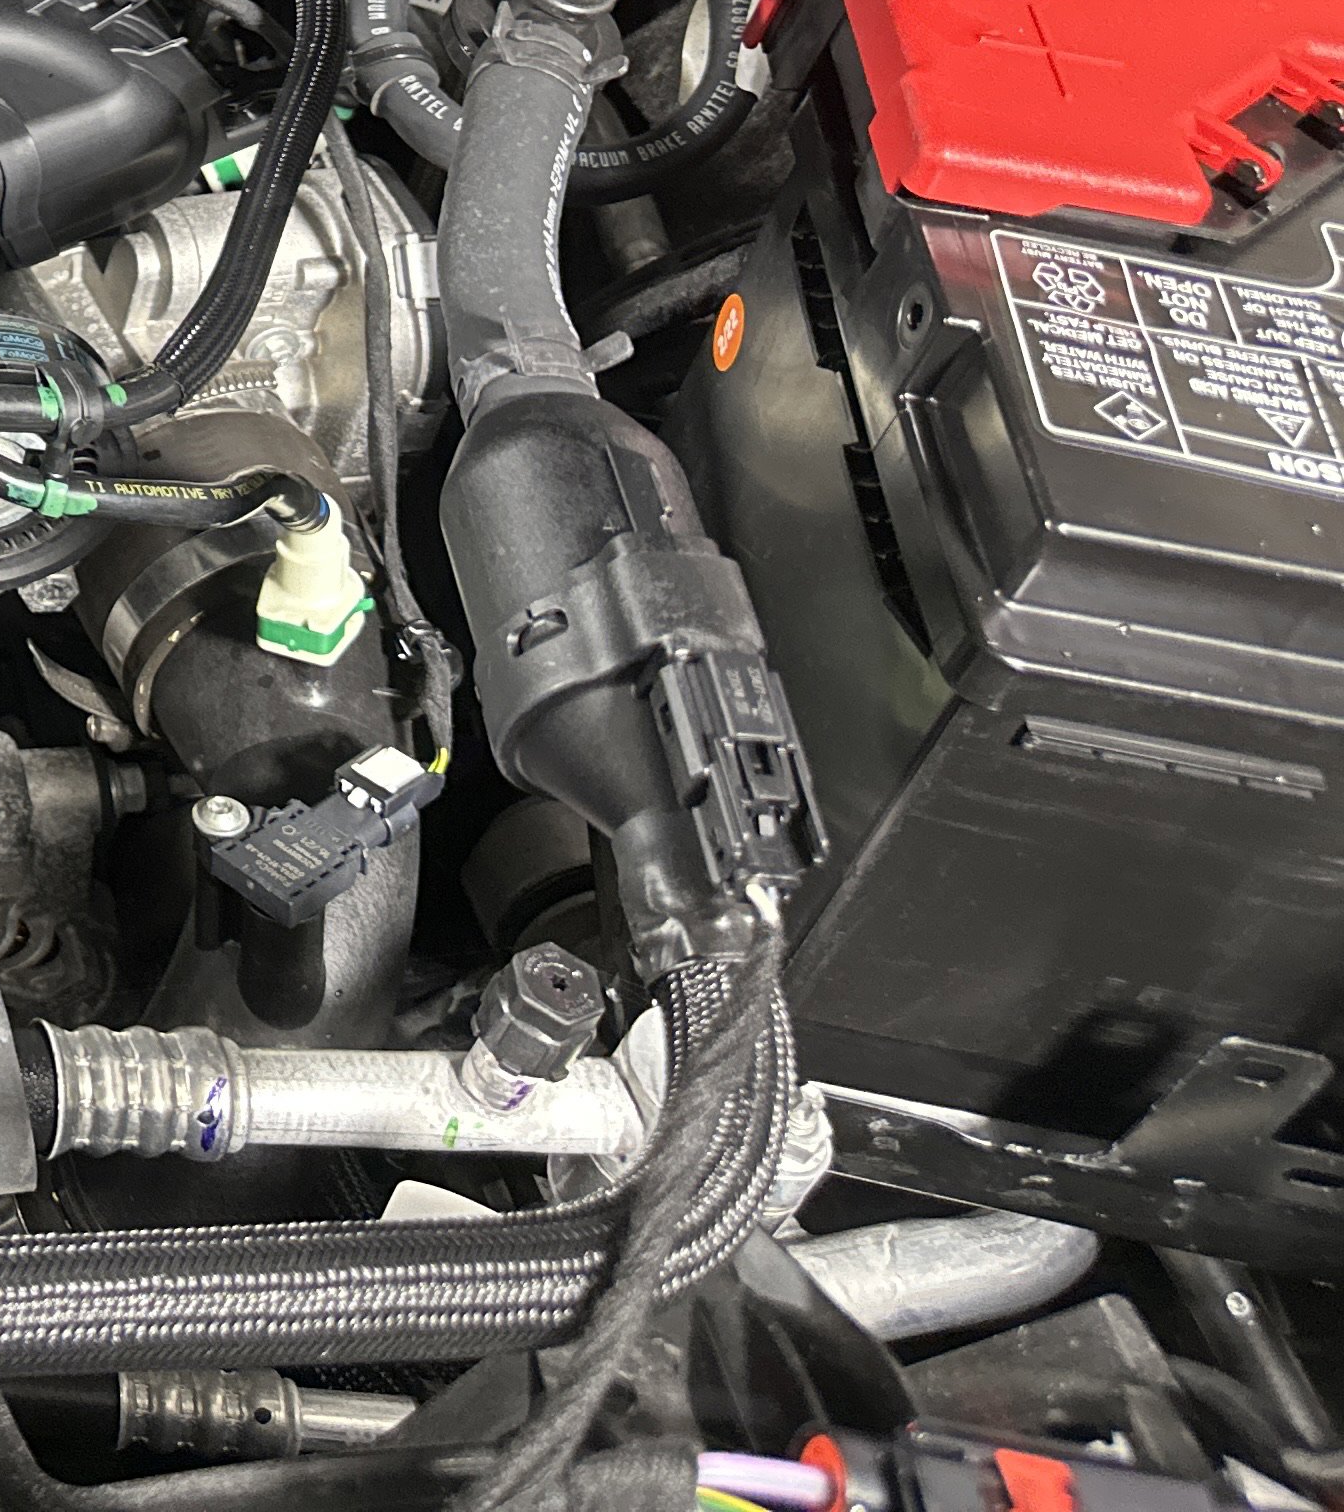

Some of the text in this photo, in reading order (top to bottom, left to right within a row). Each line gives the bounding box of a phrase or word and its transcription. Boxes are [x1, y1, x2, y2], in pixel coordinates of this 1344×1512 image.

[399, 74, 449, 119] RNITEL
[637, 131, 687, 161] BRAKE
[686, 80, 738, 135] ARNITEL
[1137, 270, 1212, 298] OPEN.
[1158, 291, 1209, 313] NOT
[1169, 308, 1208, 329] DO
[0, 349, 46, 362] FoMoCo
[1039, 340, 1149, 371] WITH WATER.
[1106, 335, 1143, 352] GET
[1256, 328, 1339, 359] KEEP OUT
[1042, 353, 1152, 385] IMMEDIATELY
[1225, 347, 1293, 370] SEVERE
[1051, 365, 1156, 398] FLUSH EYES
[1207, 370, 1303, 395] CAN CAUSE
[85, 480, 106, 493] TI
[114, 483, 208, 500] AUTOMOTIVE
